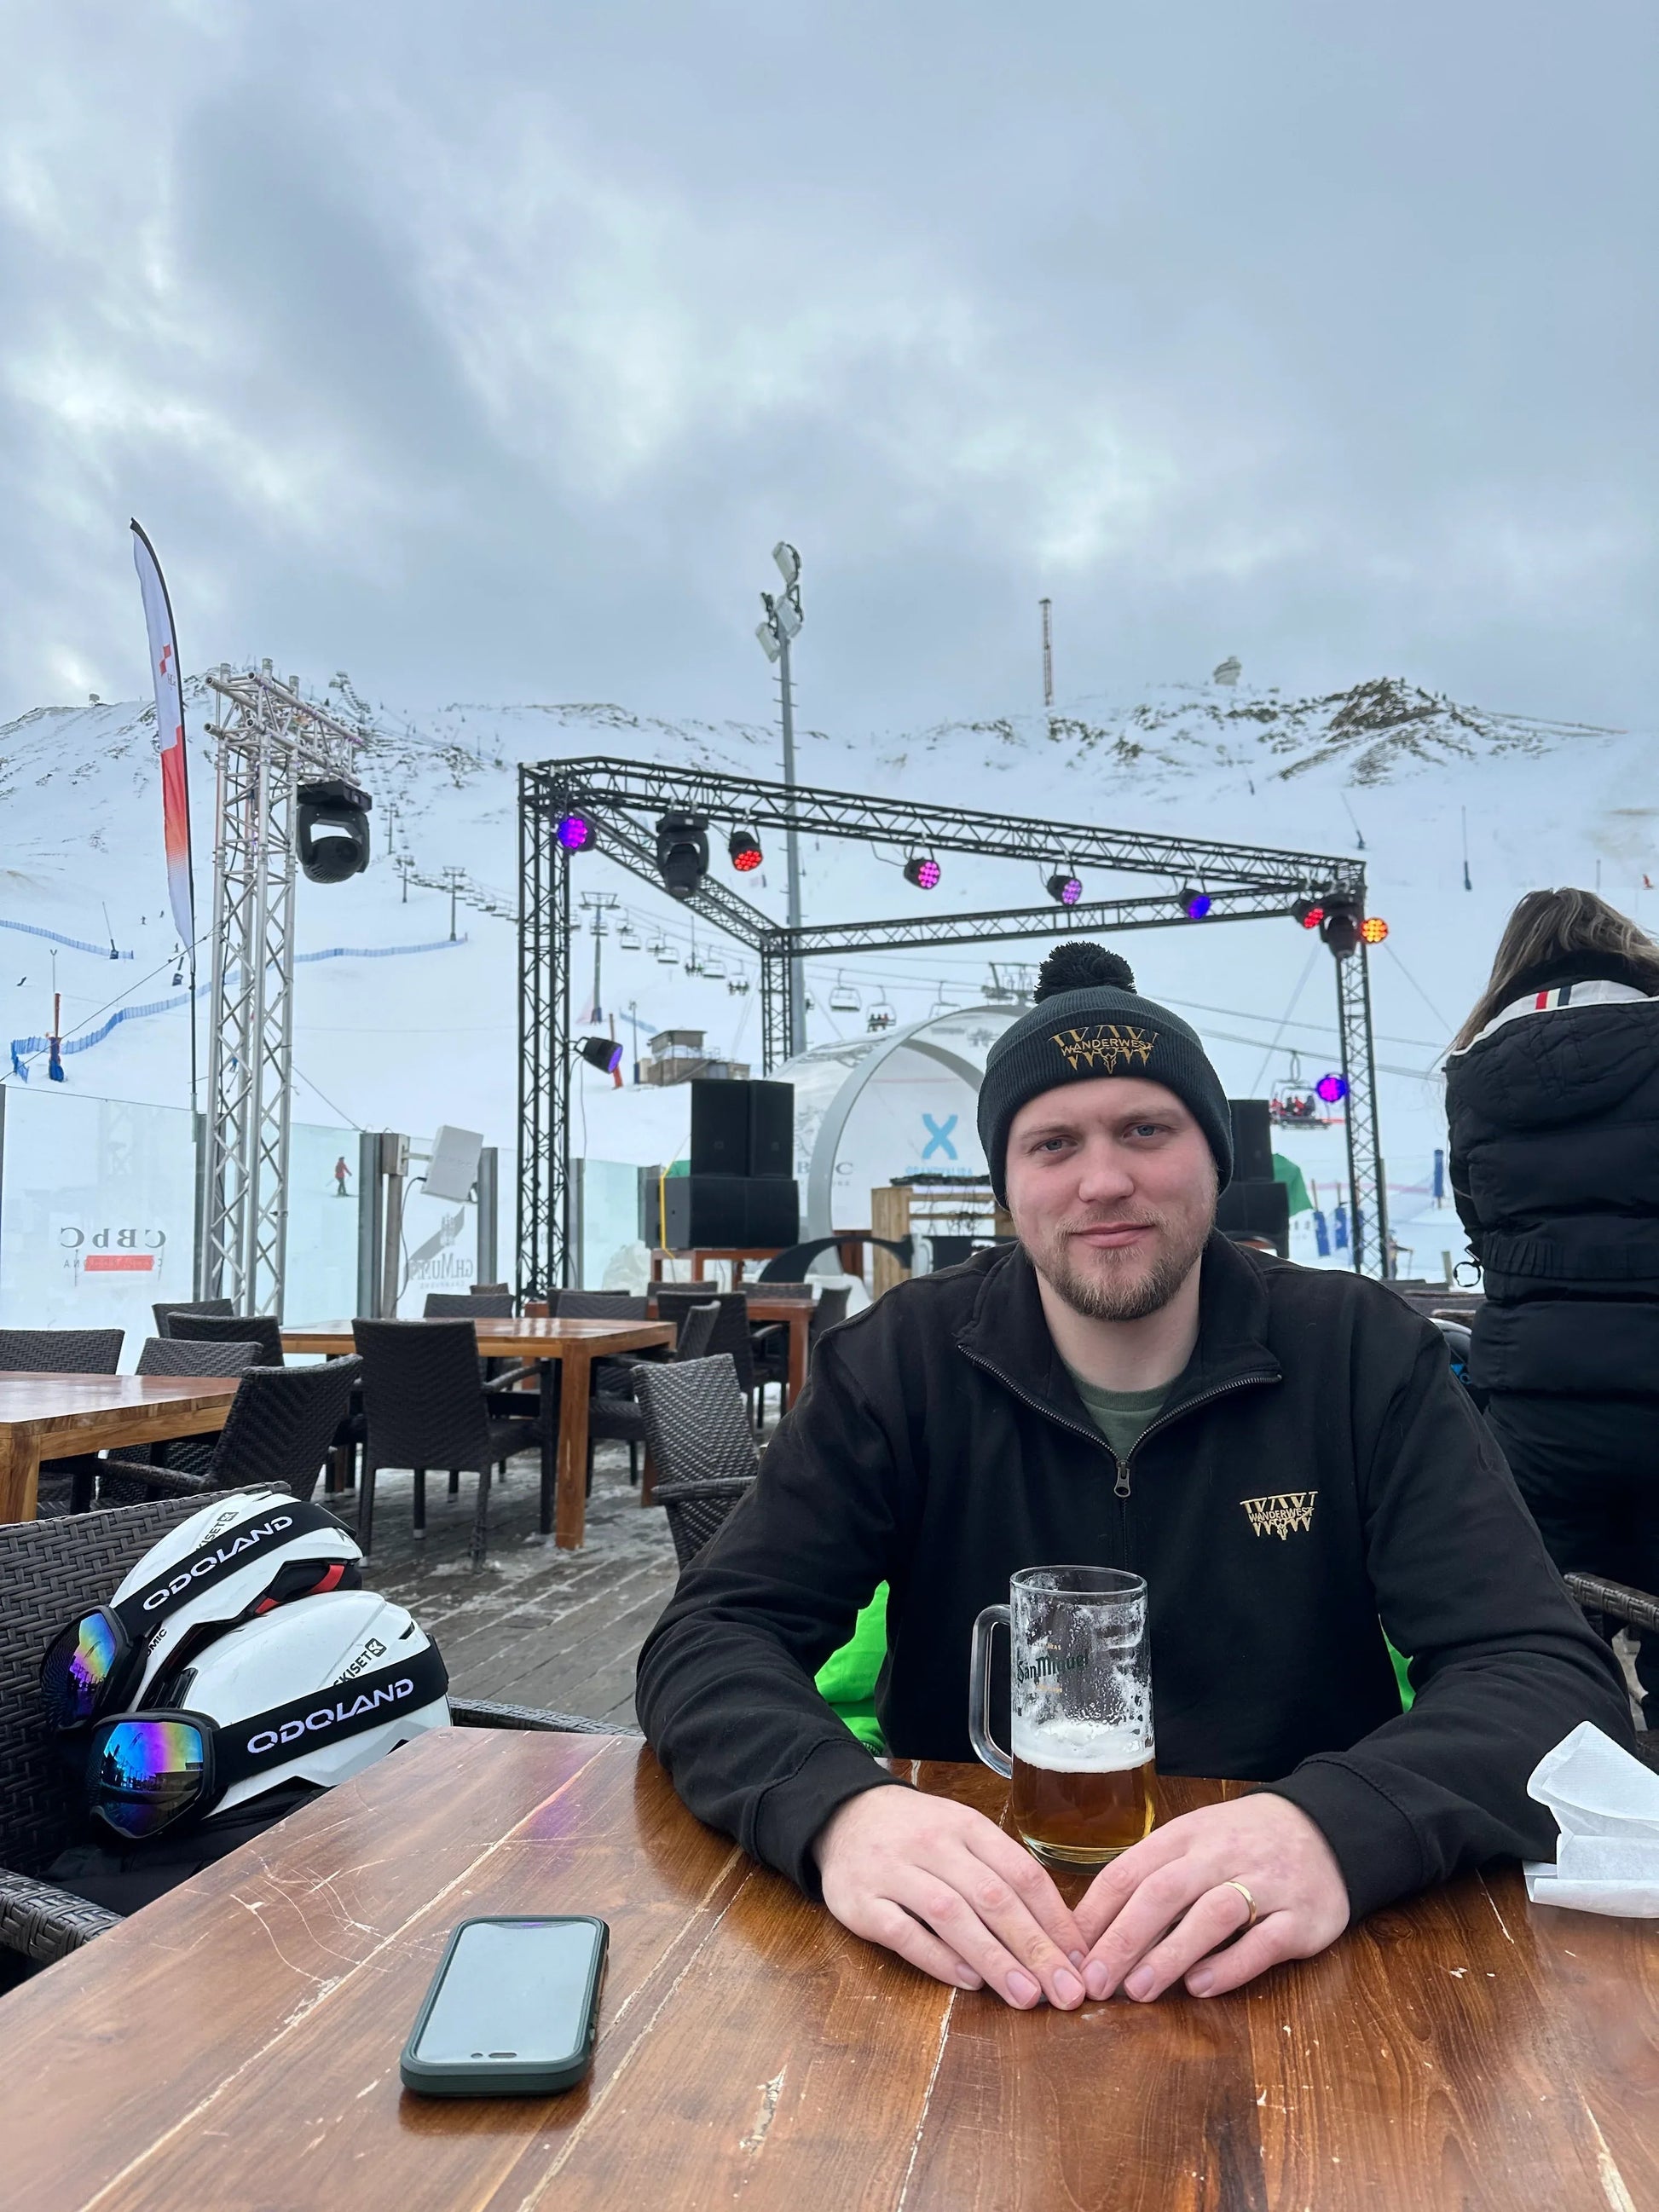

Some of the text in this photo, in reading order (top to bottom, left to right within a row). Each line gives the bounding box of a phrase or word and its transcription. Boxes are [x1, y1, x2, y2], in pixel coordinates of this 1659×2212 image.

[1061, 1037, 1154, 1057] WANDERWEST
[1248, 1506, 1315, 1523] WANDERWEST
[142, 1516, 293, 1611] ODOLAND
[247, 1678, 414, 1753] ODOLAND
